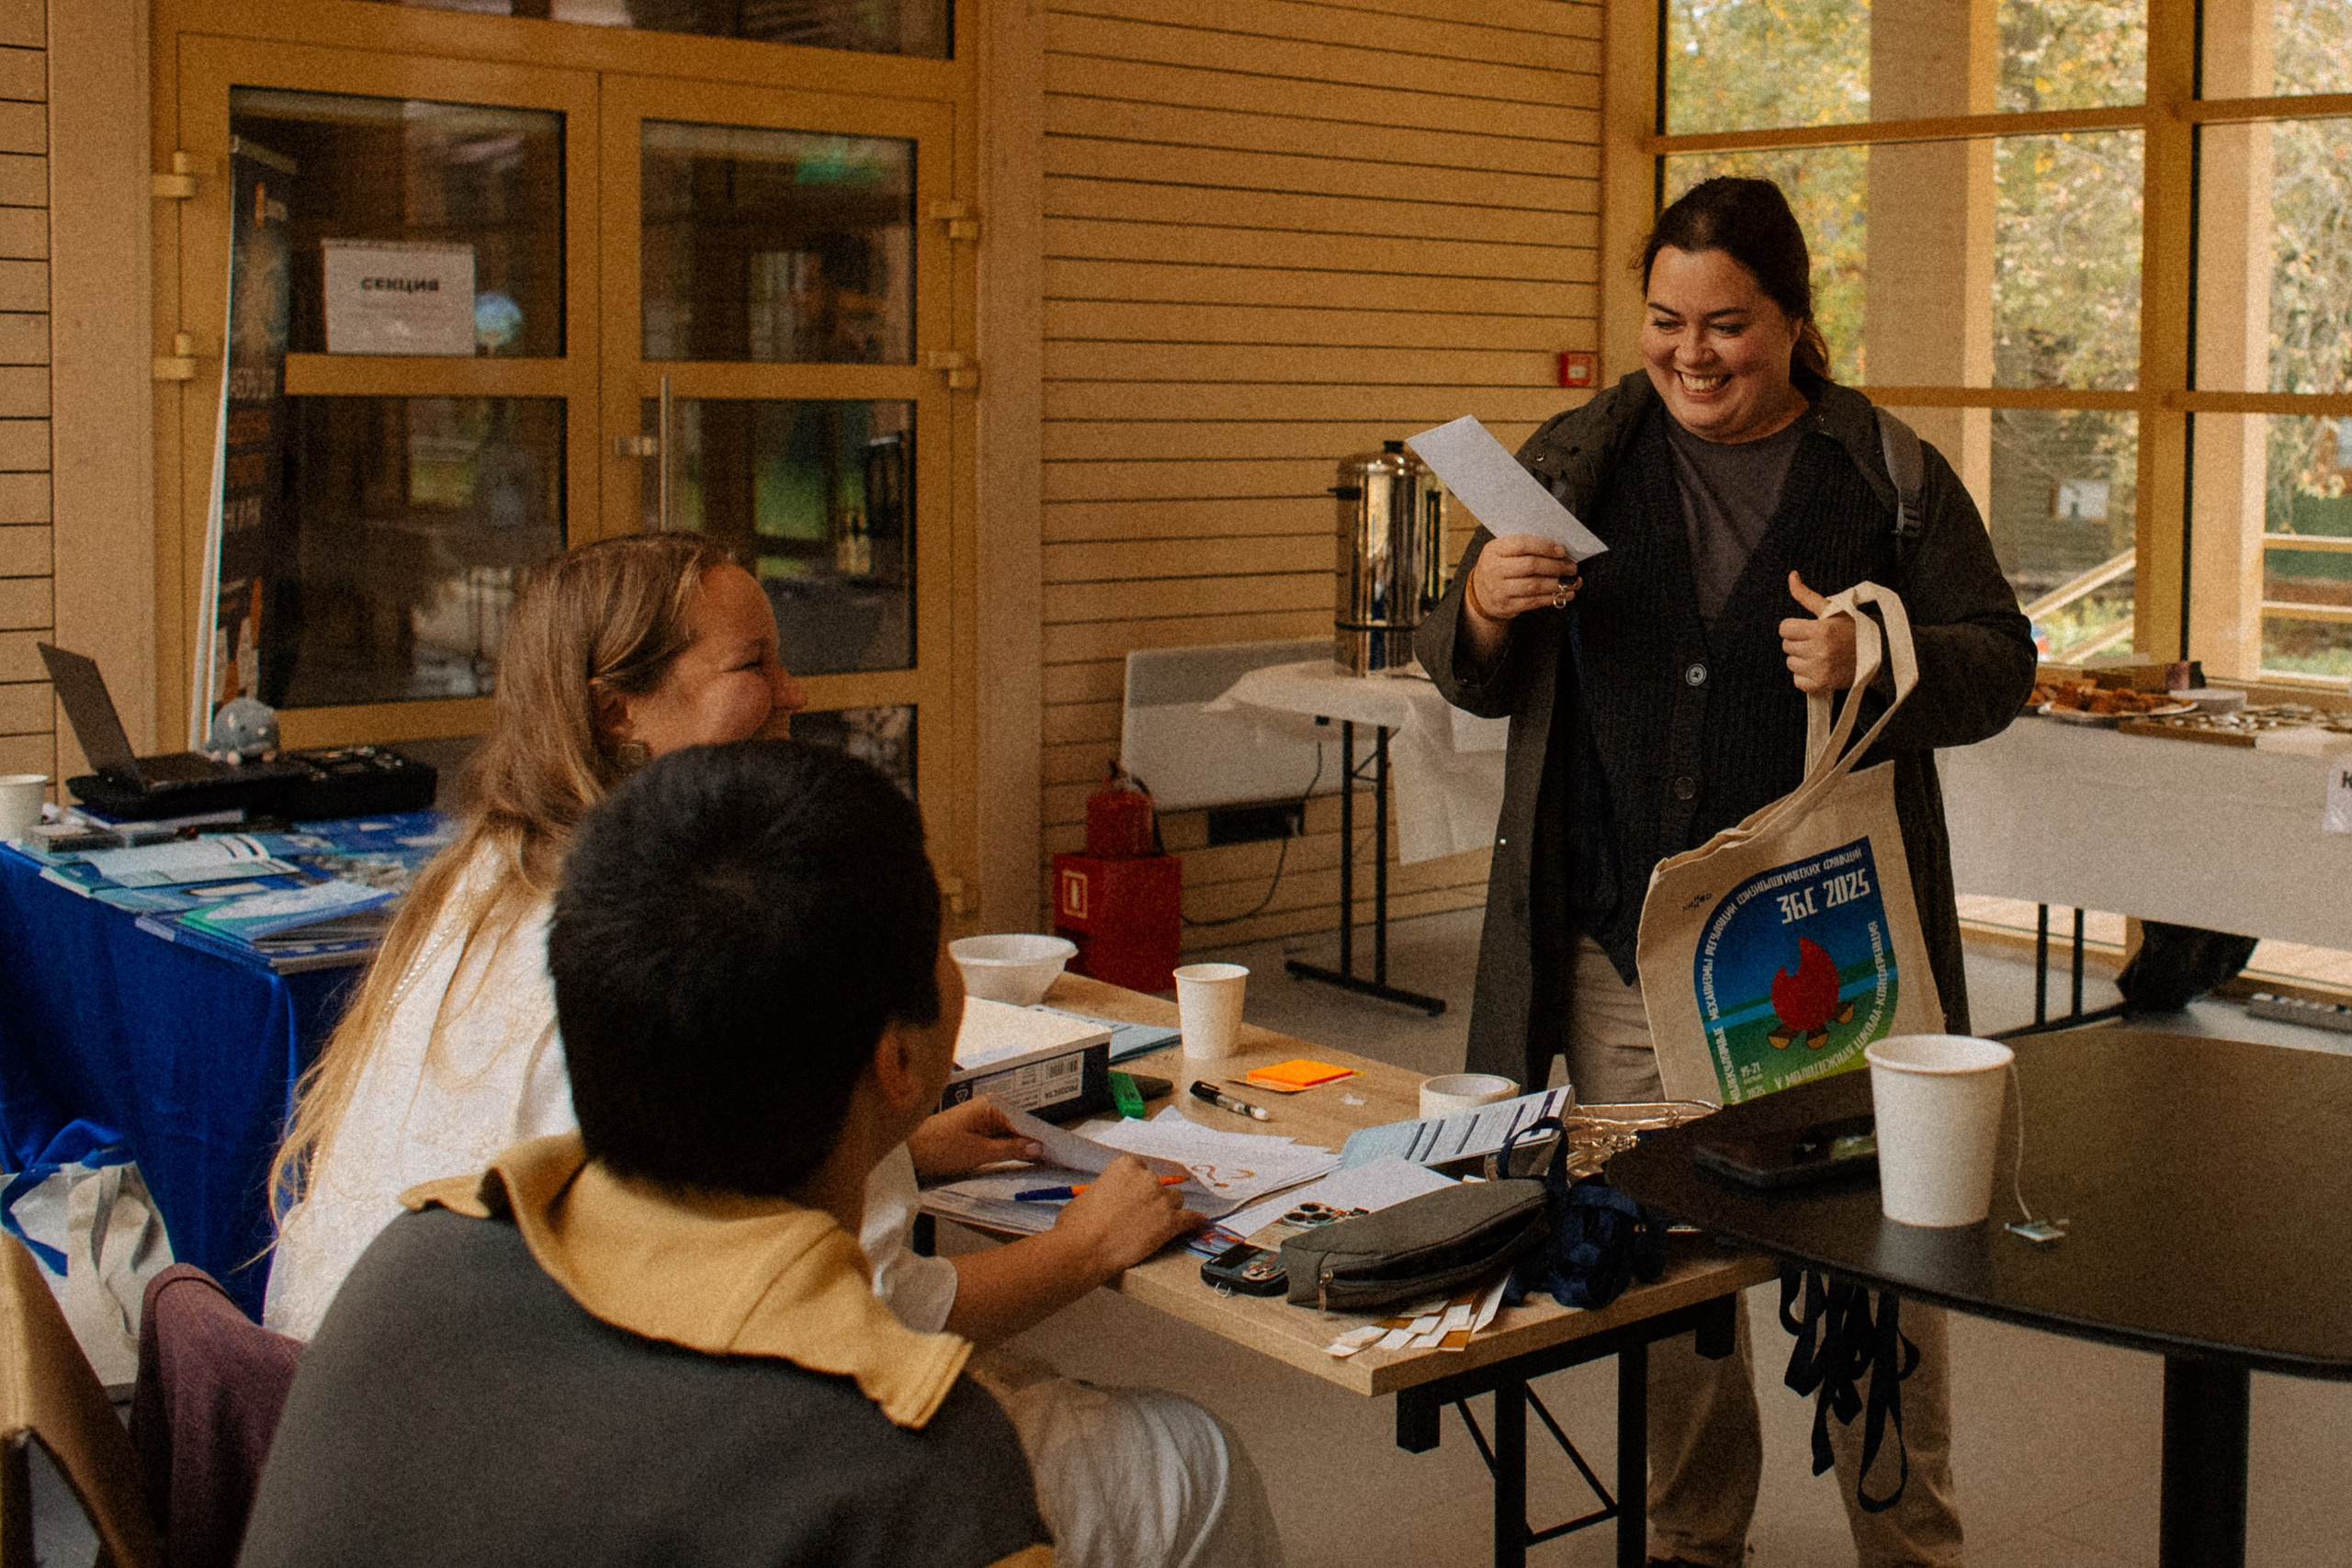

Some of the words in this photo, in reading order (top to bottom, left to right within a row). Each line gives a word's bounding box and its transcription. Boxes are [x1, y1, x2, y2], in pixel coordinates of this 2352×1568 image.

[1823, 847, 1862, 871] ФУНКЦИЙ
[1736, 863, 1821, 906] ФИЗИОЛОГИЧЕСКИХ
[1823, 868, 1871, 908] 2025
[1705, 902, 1737, 956] РЕГУЛЯЦИИ
[1702, 958, 1720, 1021] МЕХАНИЗМЫ
[1774, 1077, 1782, 1090] V
[1853, 920, 1888, 1049] ШКОЛА-КОНФЕРЕНЦИЯ
